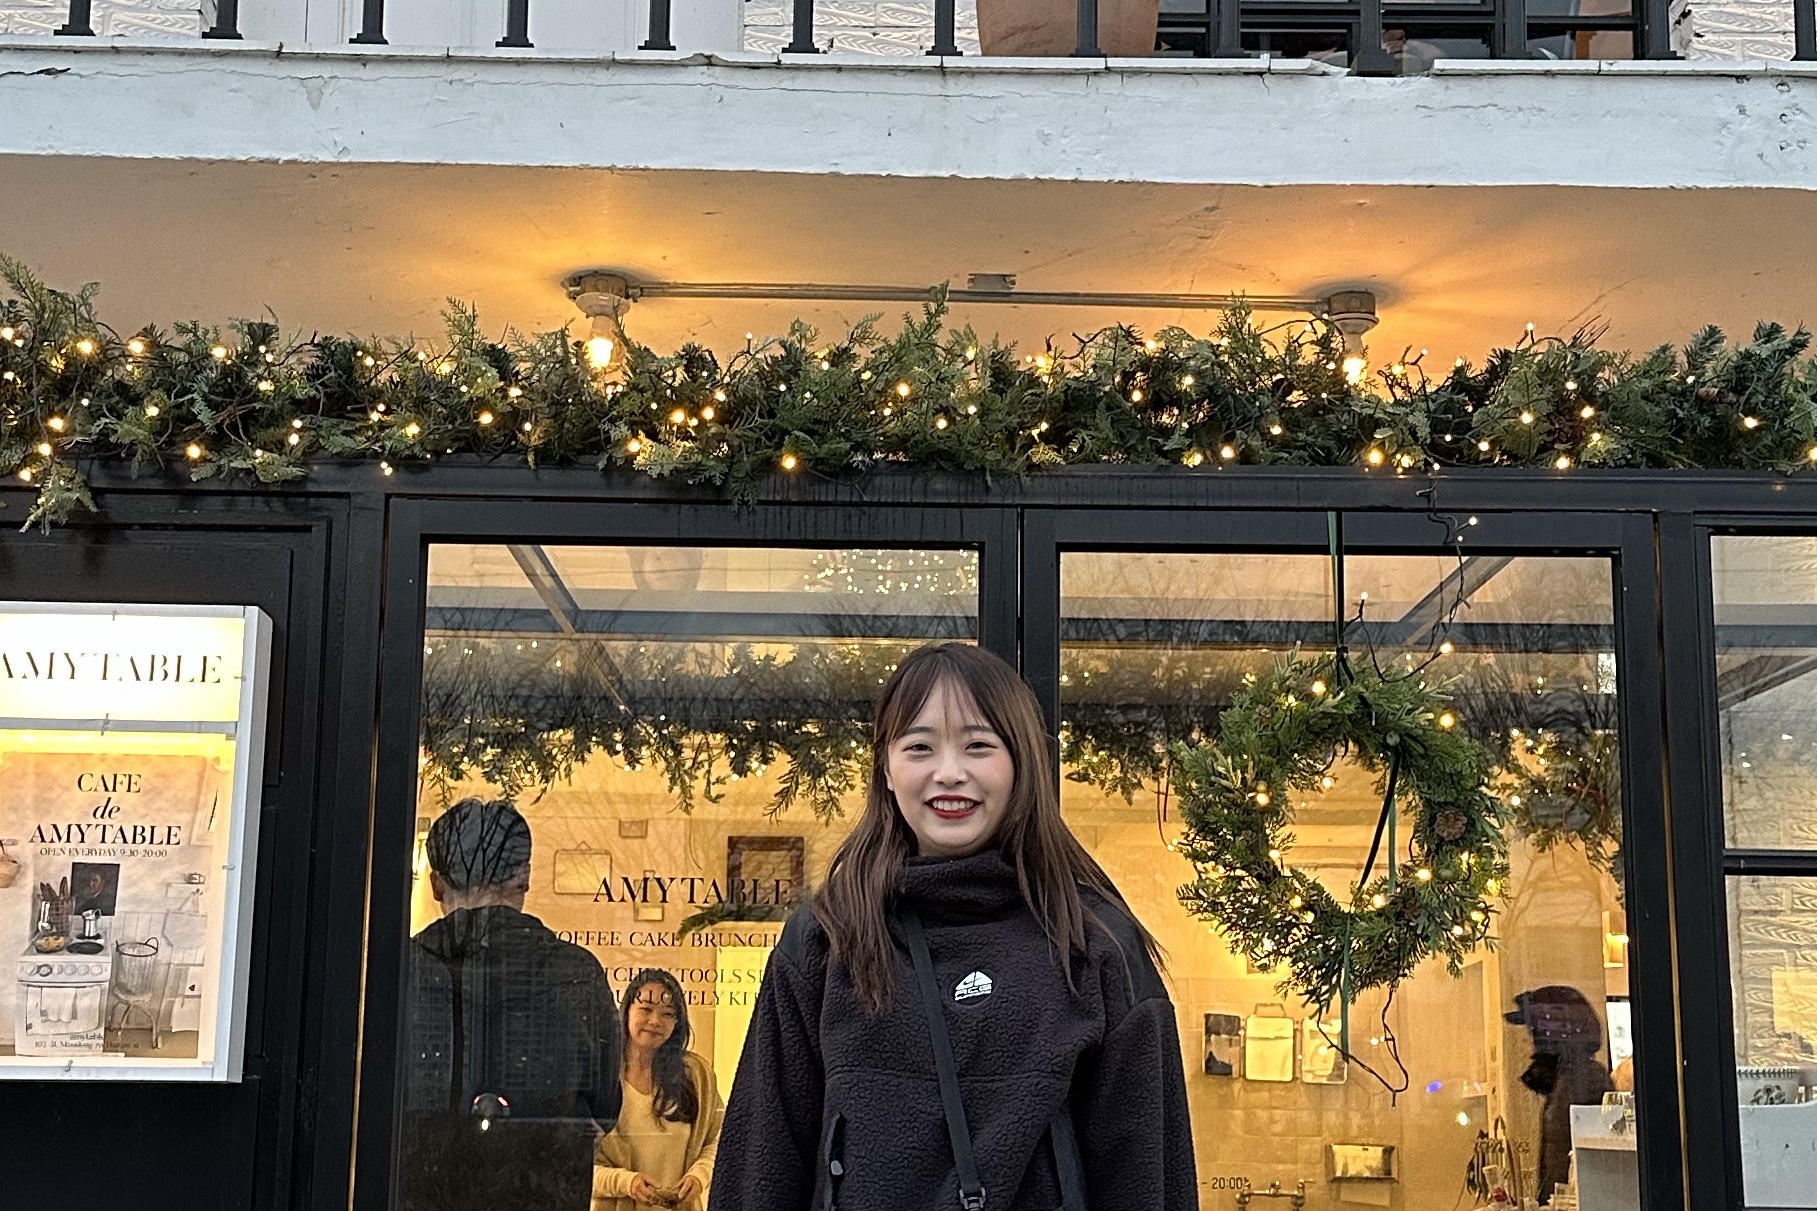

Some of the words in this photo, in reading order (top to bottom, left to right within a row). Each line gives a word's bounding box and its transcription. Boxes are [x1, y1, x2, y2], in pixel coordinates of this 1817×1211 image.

[77, 772, 142, 793] CAFE
[92, 796, 121, 820] de
[40, 847, 66, 857] OPEN
[69, 848, 116, 857] EVERYDAY
[675, 968, 742, 984] TOOLS
[1212, 1176, 1243, 1190] 20:00
